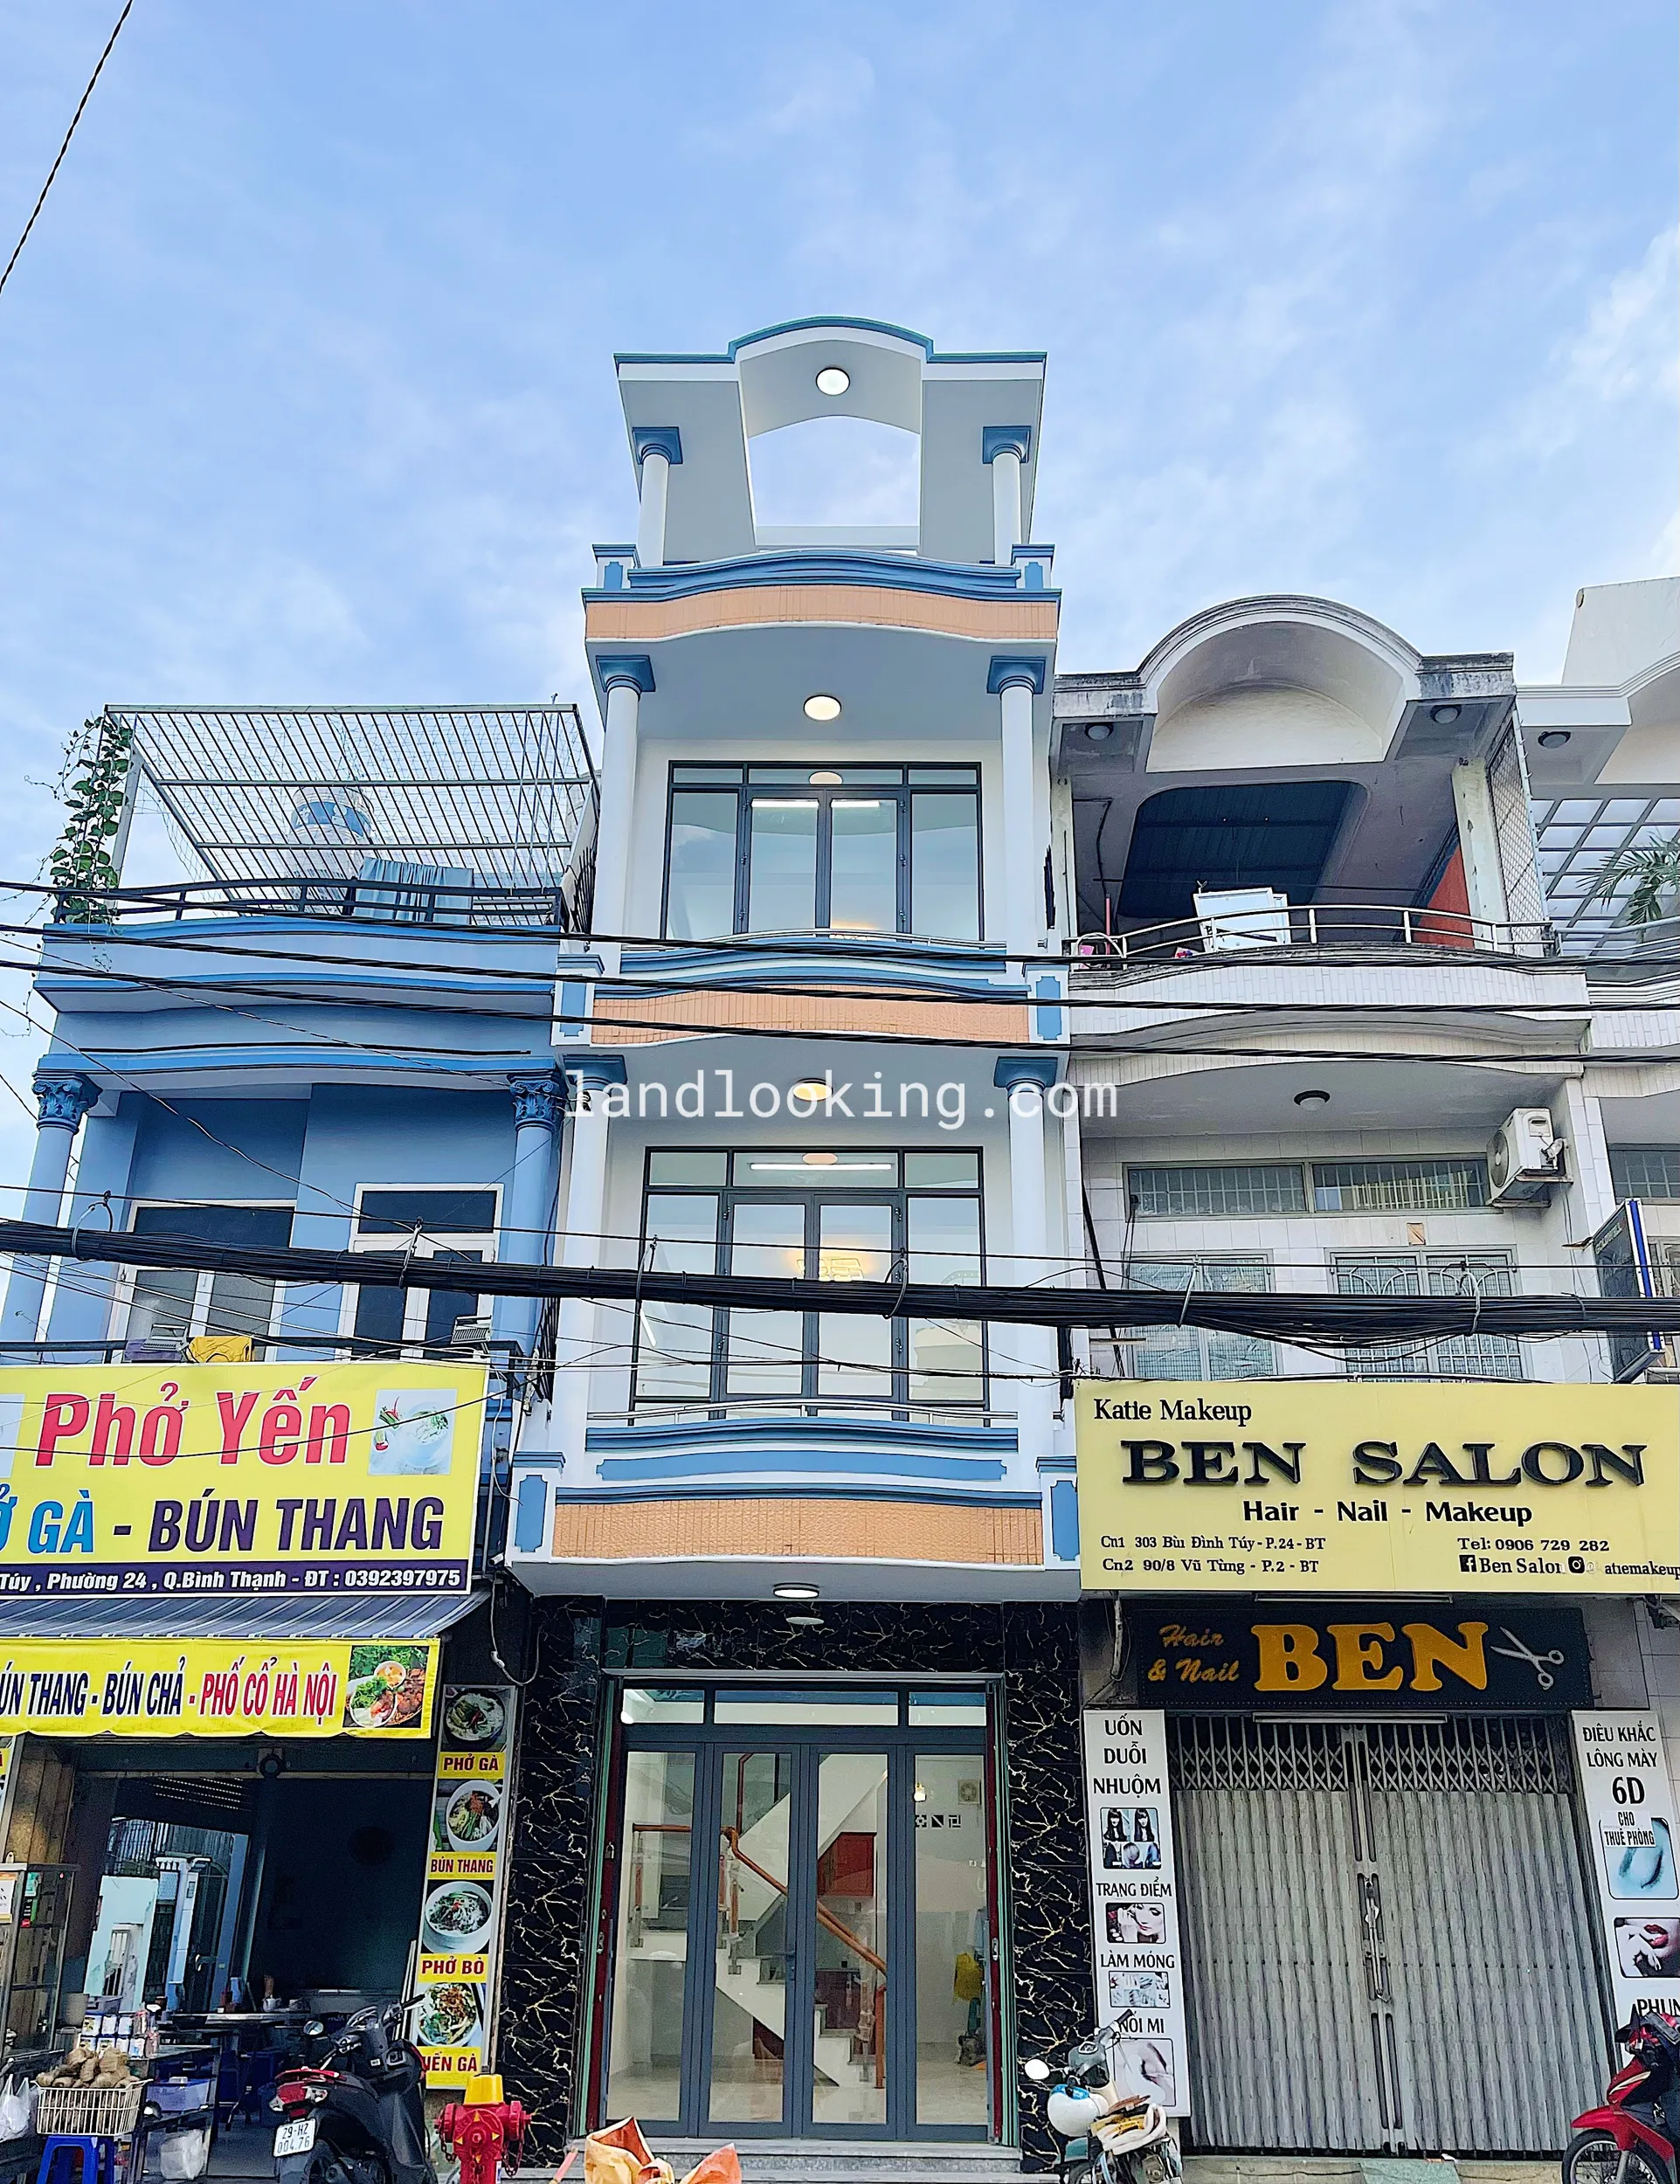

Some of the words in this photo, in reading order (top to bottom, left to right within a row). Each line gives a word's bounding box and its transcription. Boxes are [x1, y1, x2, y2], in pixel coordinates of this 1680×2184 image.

[35, 1382, 189, 1468] Phở
[216, 1376, 352, 1467] Yến
[1094, 1398, 1151, 1420] Katie
[1159, 1397, 1252, 1427] Makeup
[1120, 1440, 1307, 1486] BEN
[1352, 1440, 1649, 1487] SALON
[27, 1489, 94, 1554] GÀ
[148, 1488, 260, 1552] BÚN
[275, 1496, 445, 1552] THANG
[1243, 1500, 1300, 1523] Hair
[1338, 1500, 1389, 1523] Nail
[1426, 1500, 1533, 1526] Makeup
[1101, 1535, 1125, 1548] Cn1
[1135, 1536, 1157, 1548] 303
[1191, 1535, 1224, 1549] Đình
[1457, 1538, 1490, 1551] Tel:
[1495, 1538, 1534, 1551] 0906
[1540, 1539, 1571, 1551] 729
[1579, 1540, 1610, 1552] 282
[1103, 1559, 1134, 1572] Cn2
[1143, 1559, 1175, 1572] 90/8
[1180, 1559, 1201, 1572] Vũ
[1262, 1560, 1285, 1572] P.2
[1300, 1560, 1319, 1572] BT
[1479, 1558, 1513, 1573] Ben
[46, 1572, 119, 1591] Phường
[122, 1572, 147, 1589] 24
[163, 1571, 225, 1589] Q.Bình
[231, 1571, 287, 1592] Thạnh
[305, 1572, 329, 1588] ĐT
[345, 1570, 460, 1587] 0392397975
[1158, 1624, 1224, 1648] Hair
[1250, 1621, 1490, 1691] BEN
[1175, 1658, 1240, 1683] Nail
[28, 1672, 88, 1715] THANG
[102, 1661, 145, 1715] BÚN
[146, 1656, 186, 1715] CHẢ
[200, 1656, 245, 1716] PHỐ
[243, 1656, 278, 1716] CỔ
[272, 1662, 298, 1716] HÀ
[302, 1662, 337, 1725] NỘI
[1104, 1712, 1143, 1736] UỐN
[1582, 1722, 1614, 1742] ĐIÊU
[1617, 1720, 1656, 1742] KHẮC
[443, 1753, 475, 1771] PHỞ
[479, 1754, 499, 1771] GÀ
[1103, 1740, 1147, 1765] DUỖI
[1587, 1748, 1624, 1767] LÔNG
[1627, 1748, 1657, 1767] MÀY
[1093, 1773, 1162, 1799] NHUỘM
[1612, 1776, 1645, 1805] 6D
[431, 1856, 454, 1873] BÚN
[457, 1859, 494, 1873] THANG
[1140, 1876, 1172, 1897] ĐIỂM
[421, 1955, 458, 1974] PHỞ
[461, 1957, 485, 1975] BÒ
[1100, 1949, 1130, 1968] LÀM
[1133, 1950, 1175, 1969] MÓNG
[1147, 2018, 1165, 2034] MI
[457, 2053, 478, 2072] GÀ
